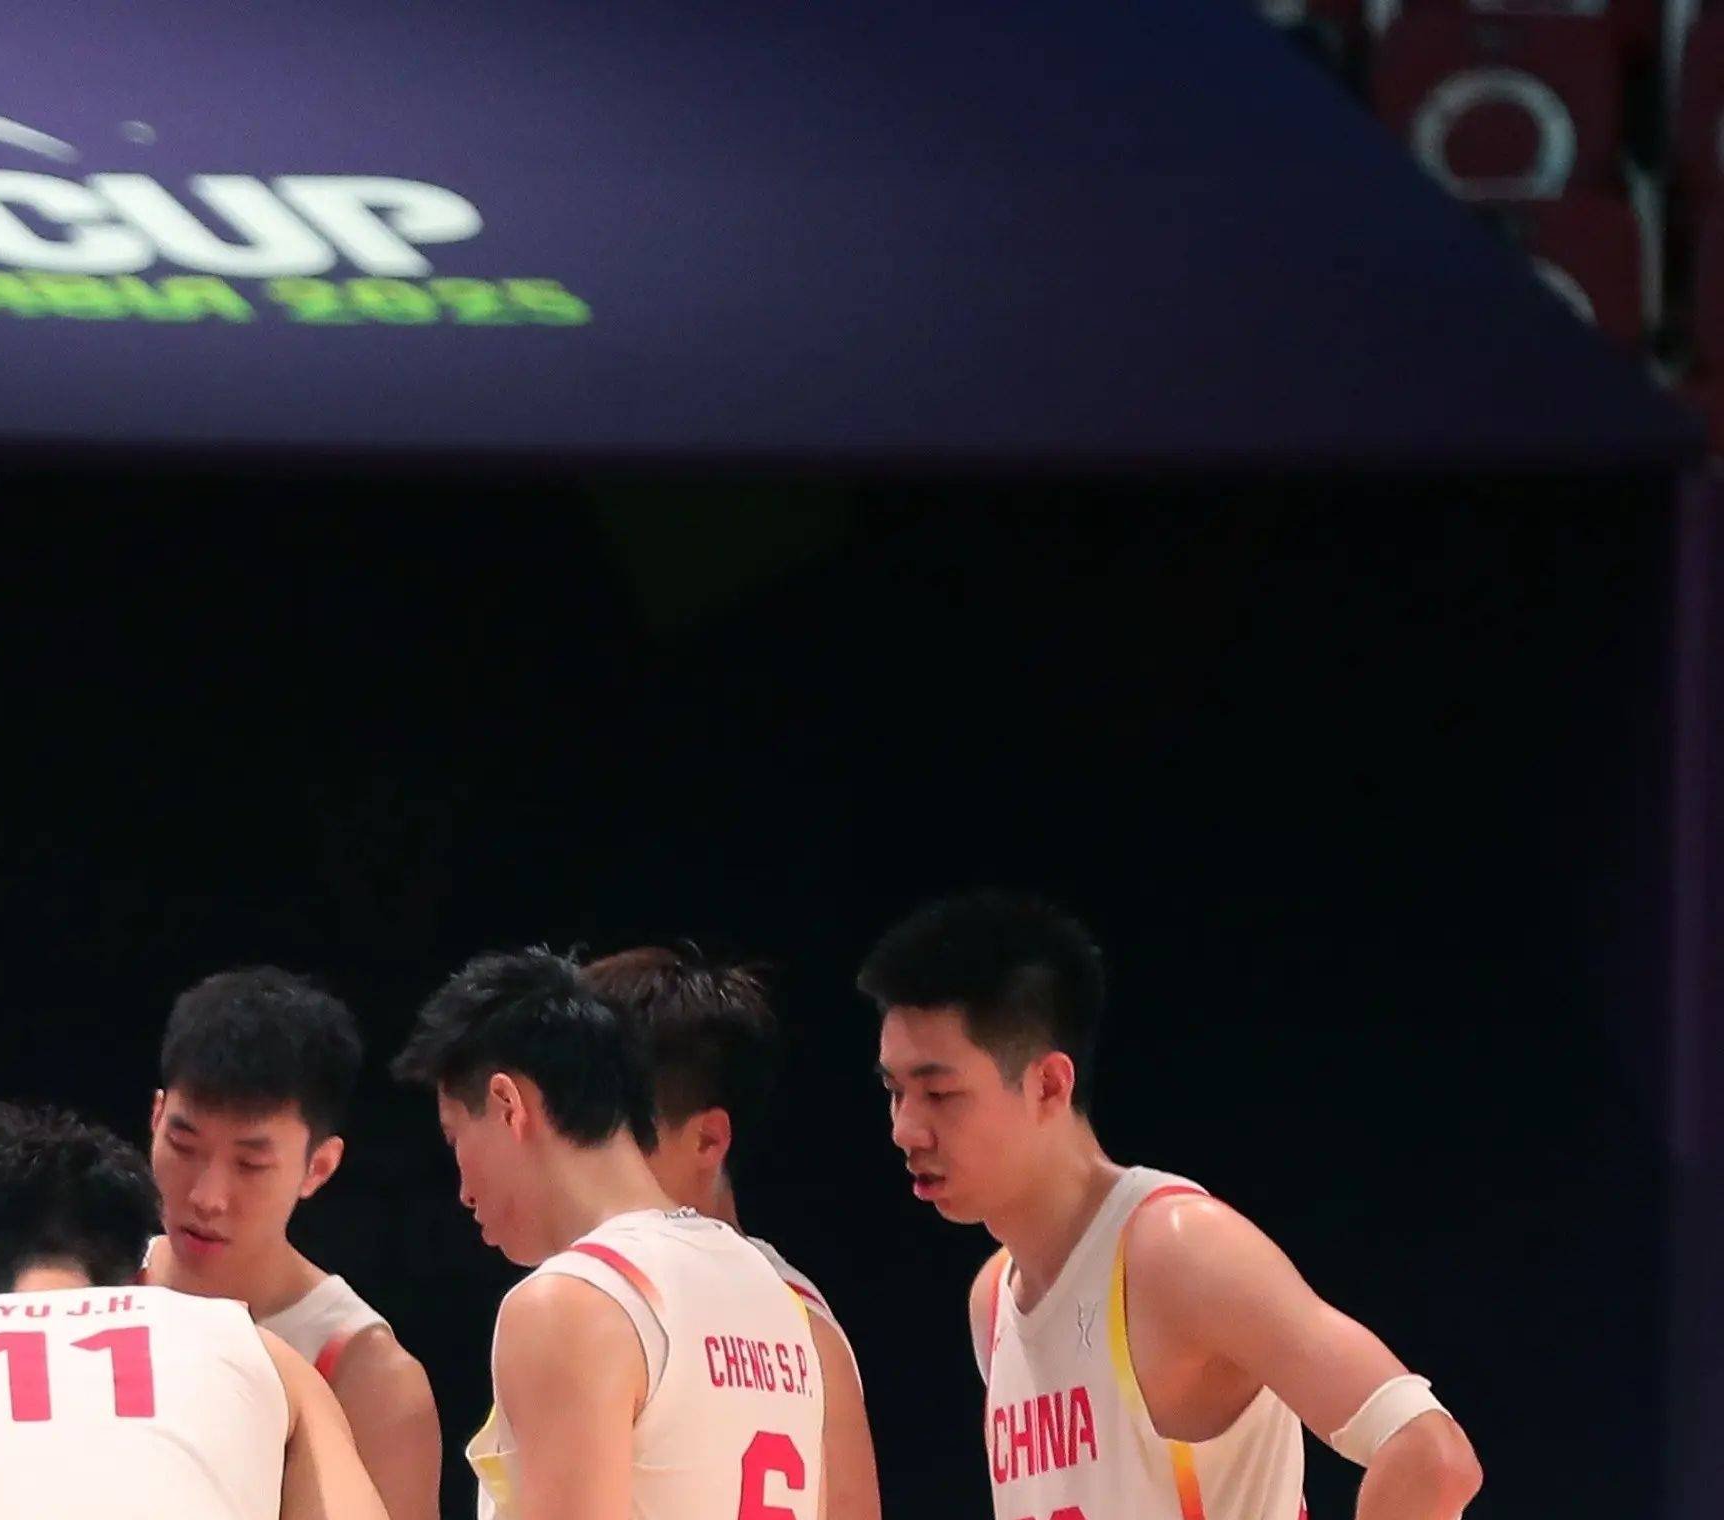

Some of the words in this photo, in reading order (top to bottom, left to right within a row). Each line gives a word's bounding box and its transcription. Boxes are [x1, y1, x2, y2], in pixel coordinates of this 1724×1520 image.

[268, 276, 590, 324] 2025
[66, 1294, 146, 1317] J.H.
[704, 1335, 776, 1392] CHENG
[775, 1342, 813, 1398] S.P.
[992, 1385, 1099, 1484] CHINA
